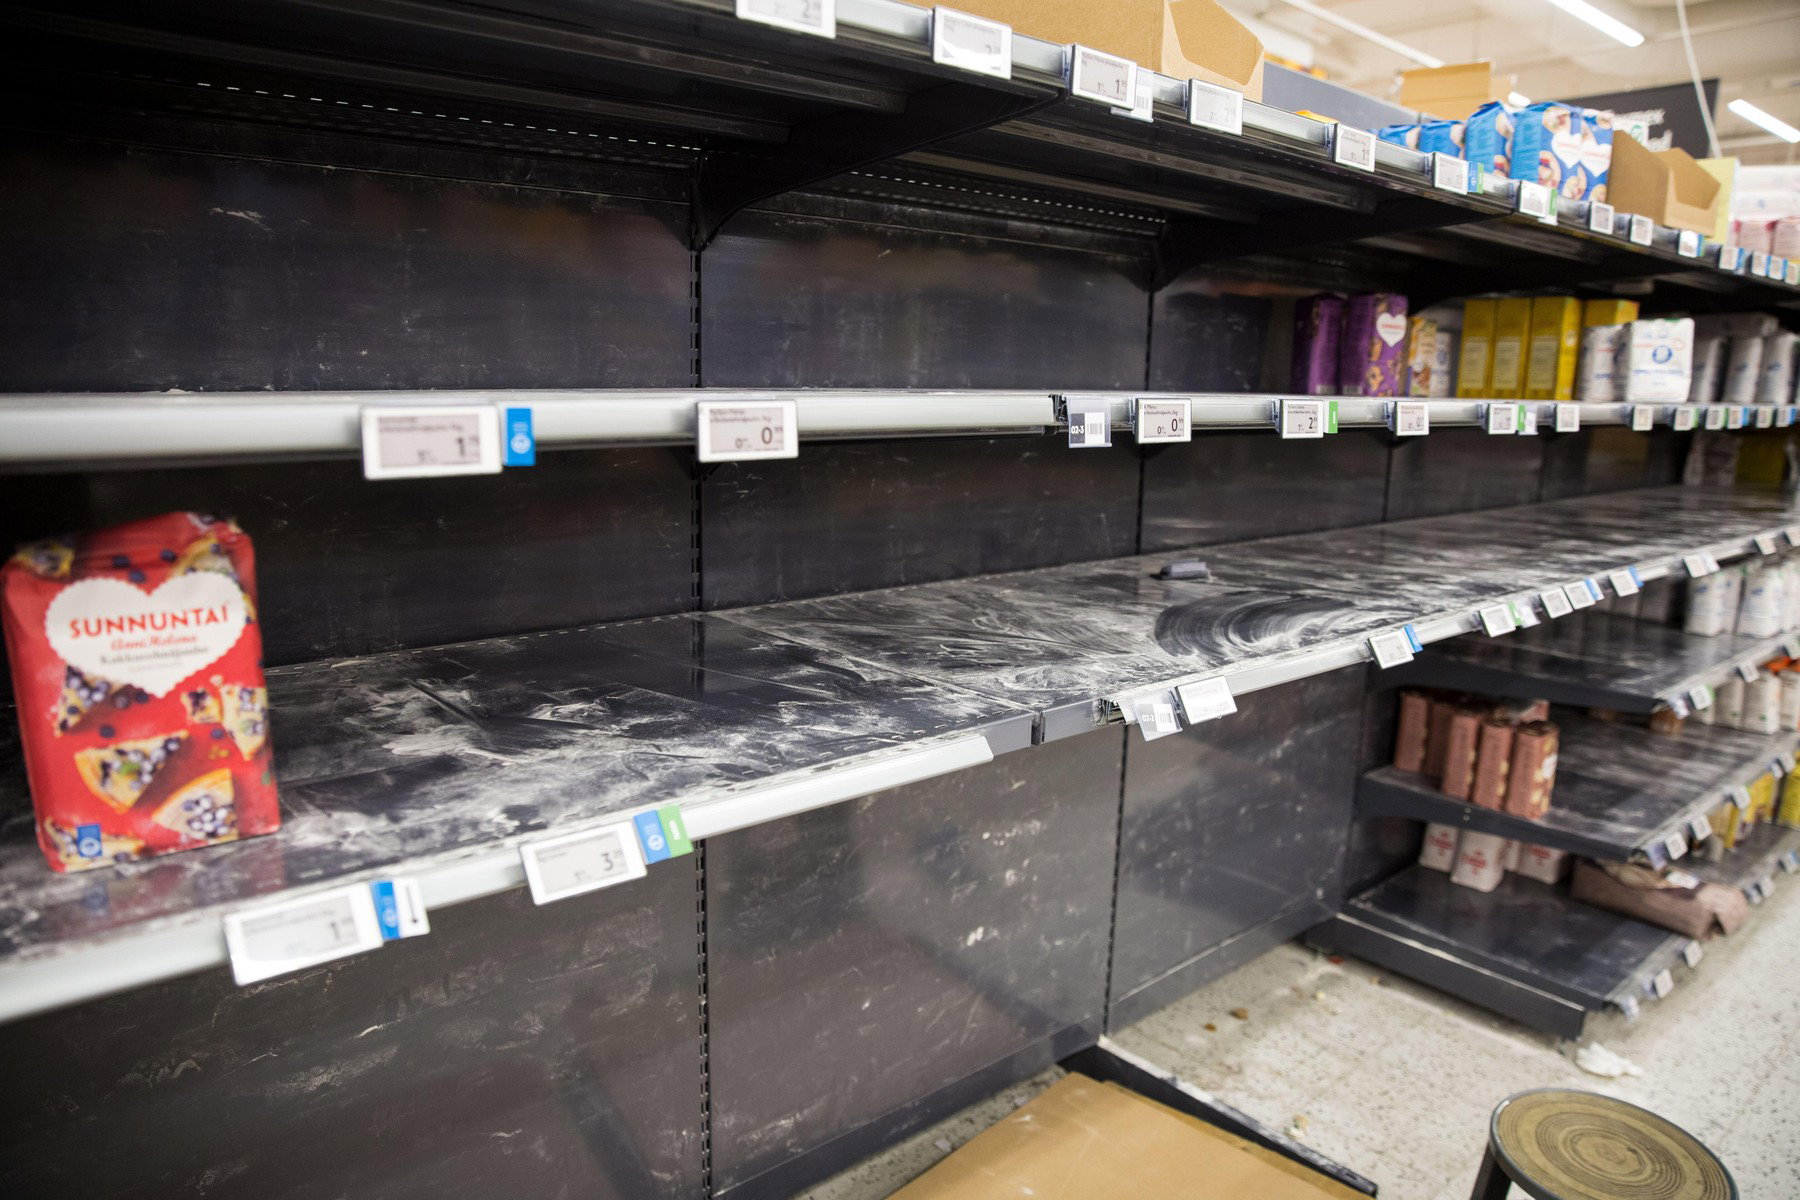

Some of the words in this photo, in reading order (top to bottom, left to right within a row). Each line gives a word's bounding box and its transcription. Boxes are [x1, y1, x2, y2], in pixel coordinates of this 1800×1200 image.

[1070, 424, 1085, 436] 02-3
[1171, 418, 1178, 432] 0
[1308, 416, 1314, 430] 2
[761, 427, 773, 446] 0
[69, 605, 229, 639] SUNNUNTAI
[1141, 713, 1155, 722] 02-2
[600, 852, 614, 873] 3
